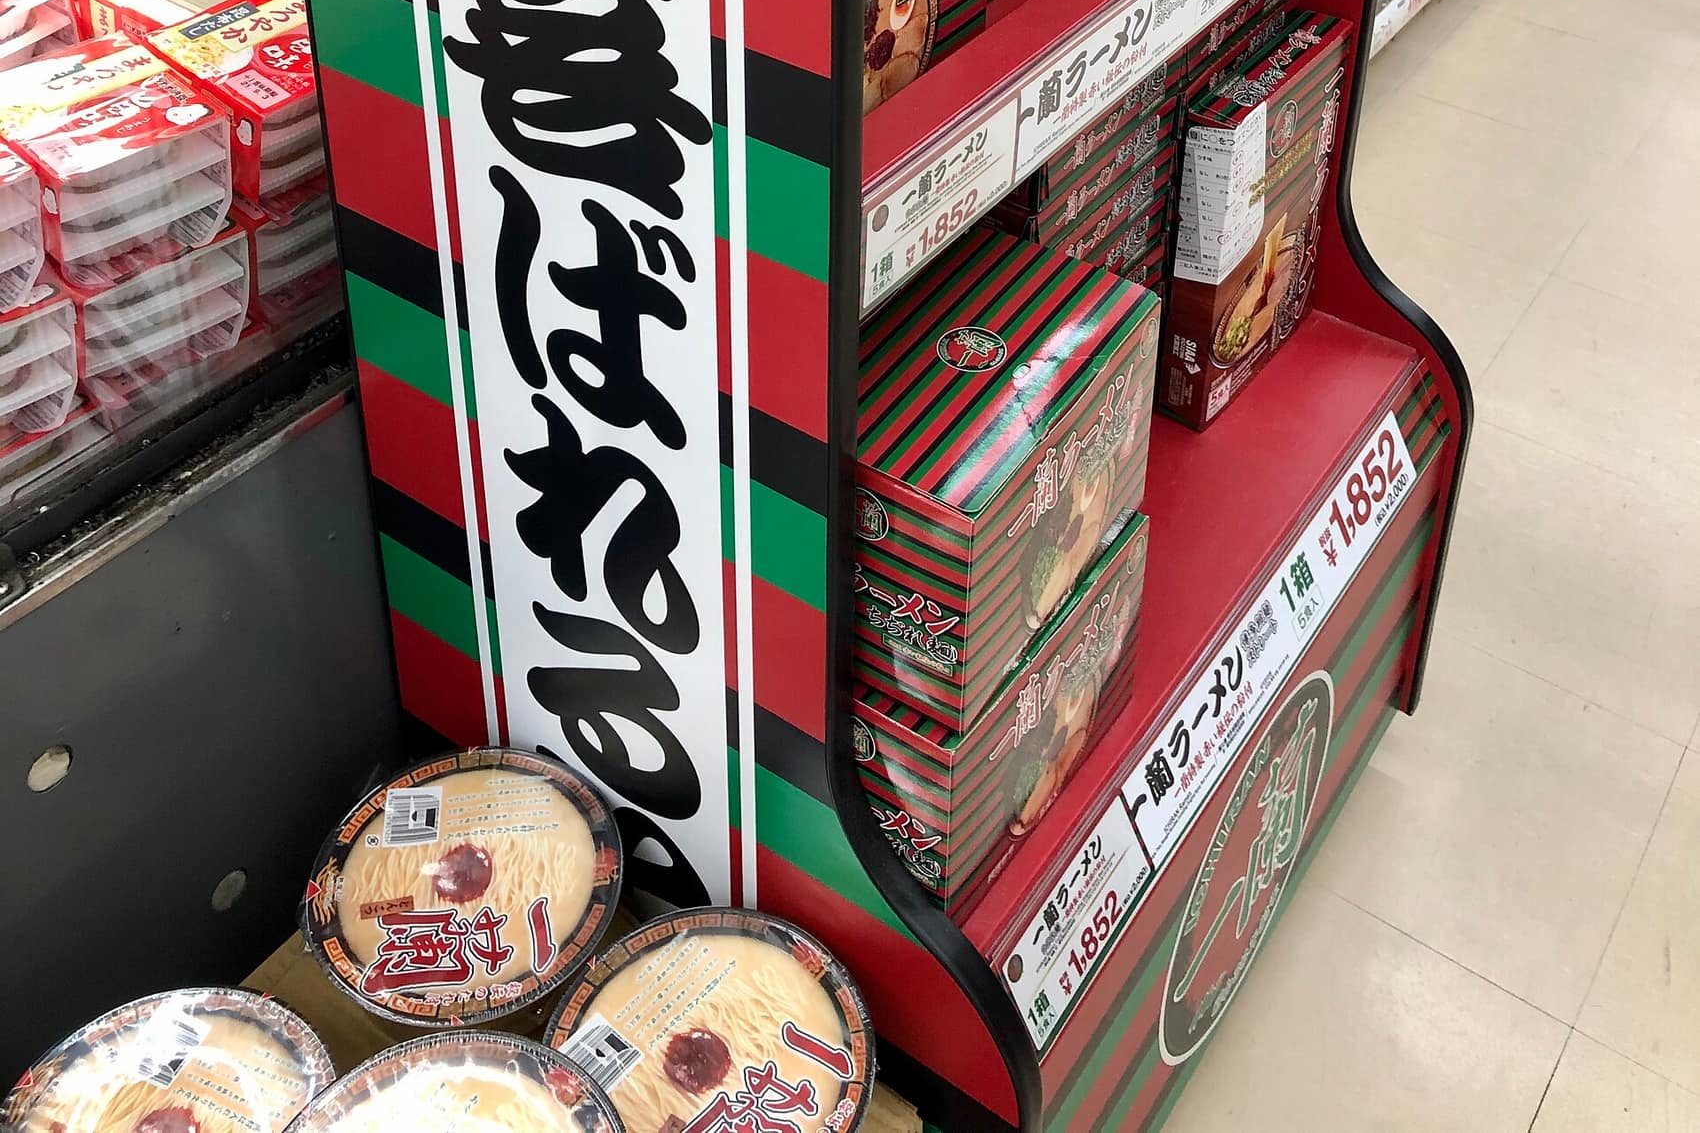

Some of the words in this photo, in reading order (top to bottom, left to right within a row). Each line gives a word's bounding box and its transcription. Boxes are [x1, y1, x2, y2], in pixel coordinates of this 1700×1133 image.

[1018, 1, 1153, 125] 一蘭ラーメン
[901, 127, 988, 206] 一蘭ラーメン
[1008, 364, 1134, 539] 一蘭ラーメン
[1322, 428, 1404, 568] ¥1,852
[1279, 550, 1315, 613] 1箱
[1299, 596, 1321, 630] 5食入
[866, 604, 959, 666] ちぢれ麺
[1130, 645, 1243, 822] 一蘭ラーメン
[1032, 834, 1102, 945] 一蘭ラーメン
[359, 895, 557, 997] 一蘭
[1027, 989, 1050, 1026] 1箱
